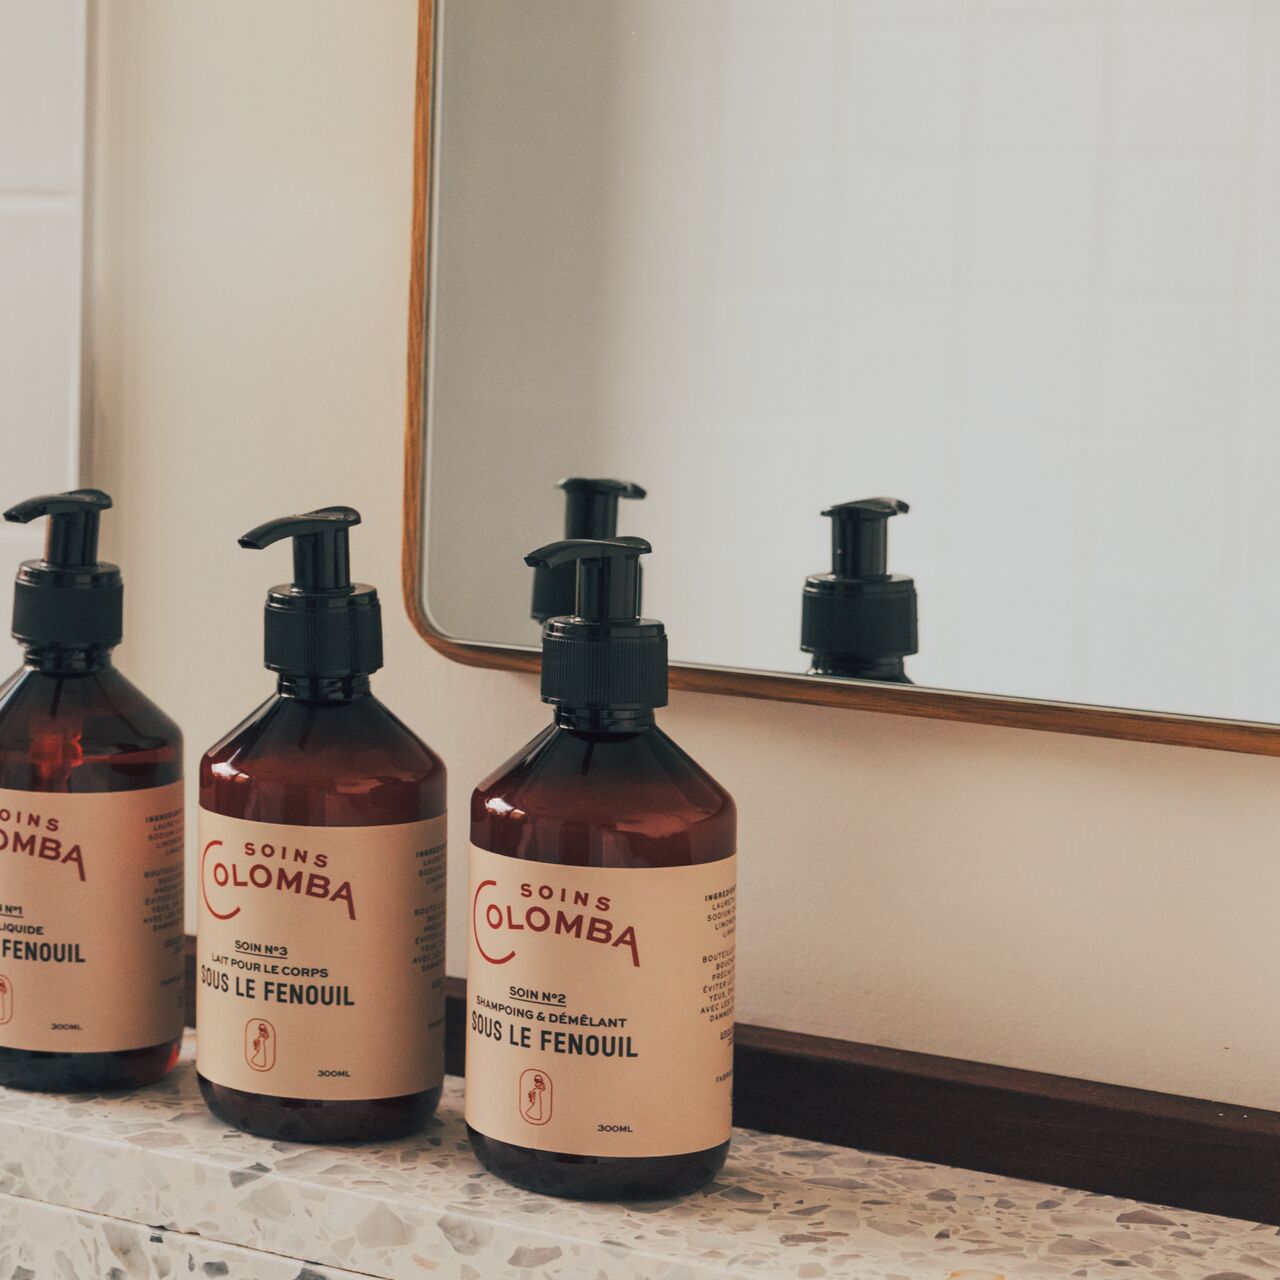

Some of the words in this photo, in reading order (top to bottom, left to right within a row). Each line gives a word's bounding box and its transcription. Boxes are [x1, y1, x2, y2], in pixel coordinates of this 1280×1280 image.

[244, 842, 328, 868] SOINS
[201, 840, 356, 920] COLOMBA
[520, 883, 611, 911] SOINS
[473, 879, 640, 968] COLOMBA
[2, 938, 86, 963] FENOUIL
[235, 939, 261, 953] SOIN
[211, 952, 229, 964] LAIT
[231, 958, 261, 972] POUR
[264, 964, 279, 975] LE
[281, 966, 329, 978] CORPS
[201, 964, 229, 993] SOUS
[235, 976, 255, 999] LE
[264, 981, 355, 1006] FENOUIL
[509, 986, 538, 1000] SOIN
[476, 995, 534, 1020] SHAMPOING
[536, 1011, 546, 1022] &
[549, 1012, 627, 1028] DÉMÊLANT
[51, 1023, 82, 1031] 300ML
[472, 1010, 502, 1042] SOUS
[509, 1024, 531, 1048] LE
[540, 1029, 638, 1058] FENOUIL
[597, 1124, 633, 1133] 300ML
